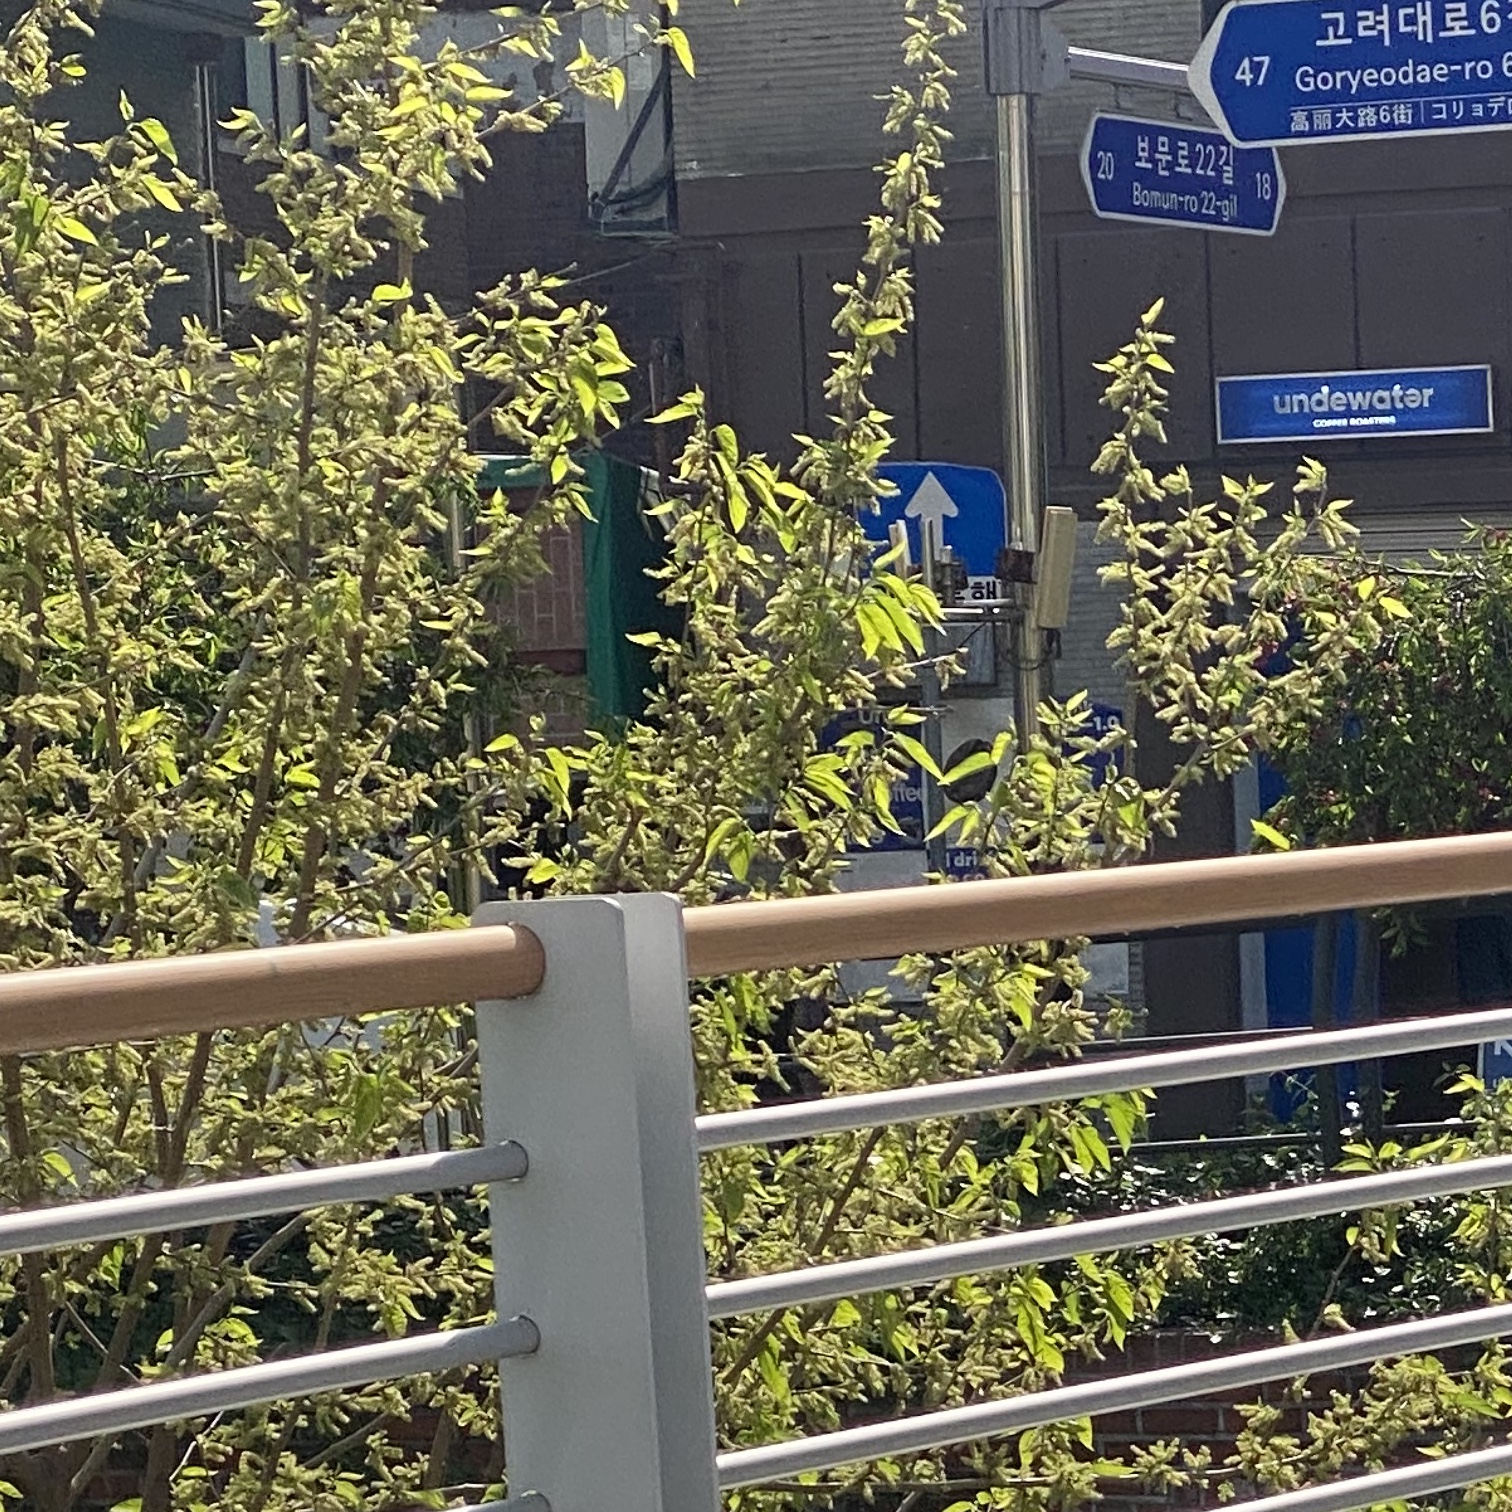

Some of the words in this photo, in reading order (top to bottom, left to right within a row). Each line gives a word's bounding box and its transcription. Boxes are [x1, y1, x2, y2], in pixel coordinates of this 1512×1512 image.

[1235, 55, 1270, 86] 47
[1295, 58, 1493, 94] Goryeodae-ro
[1097, 151, 1115, 180] 20
[1134, 134, 1234, 185] 보문로22길
[1132, 181, 1198, 213] Bomun-ro
[1201, 190, 1238, 222] 22-gil
[1255, 172, 1272, 200] 18
